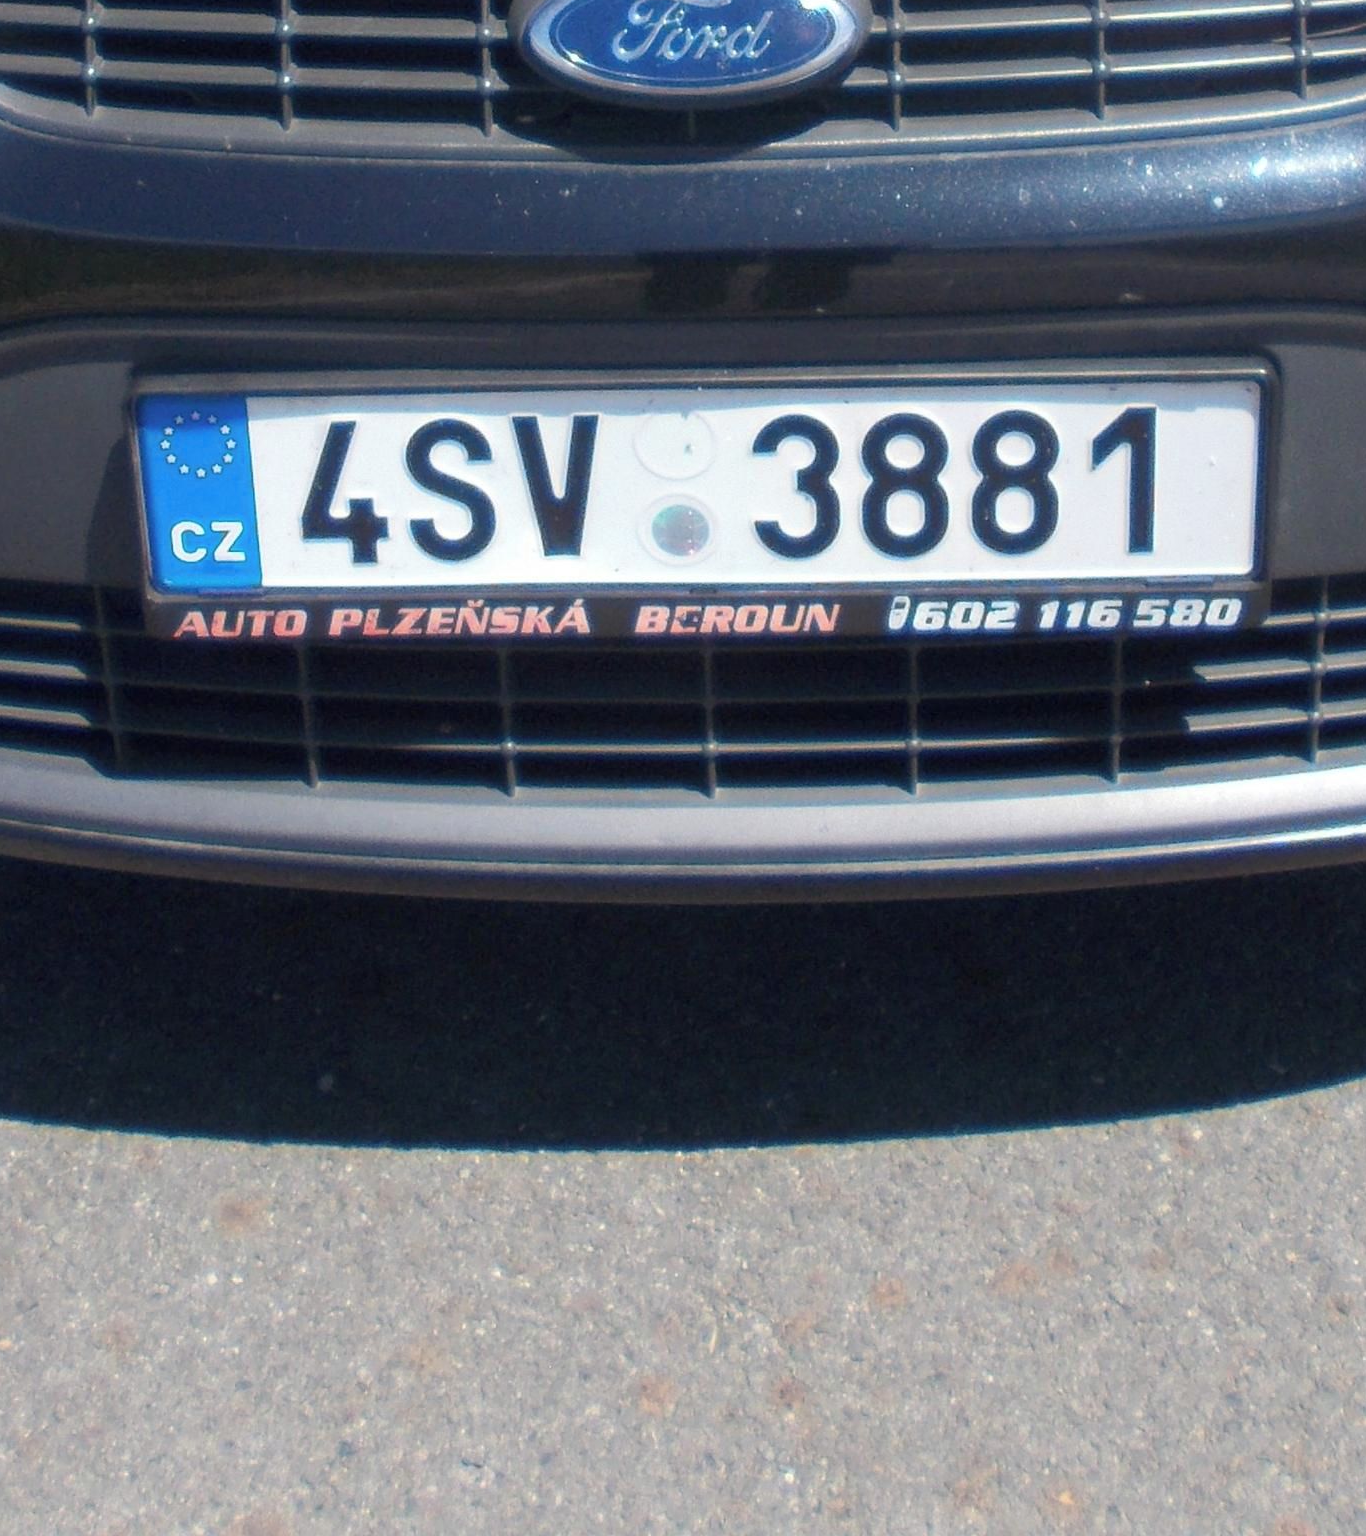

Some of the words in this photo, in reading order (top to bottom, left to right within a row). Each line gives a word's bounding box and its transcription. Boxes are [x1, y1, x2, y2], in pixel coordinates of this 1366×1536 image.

[300, 414, 601, 564] 4SV
[753, 406, 1158, 561] 3881
[171, 520, 247, 562] CZ
[173, 610, 307, 638] AUTO
[329, 599, 591, 635] PLZEŇSKÁ
[634, 604, 841, 634] BEROUN
[913, 600, 1020, 631] 602
[1039, 599, 1123, 628] 116
[1133, 598, 1243, 627] 580
